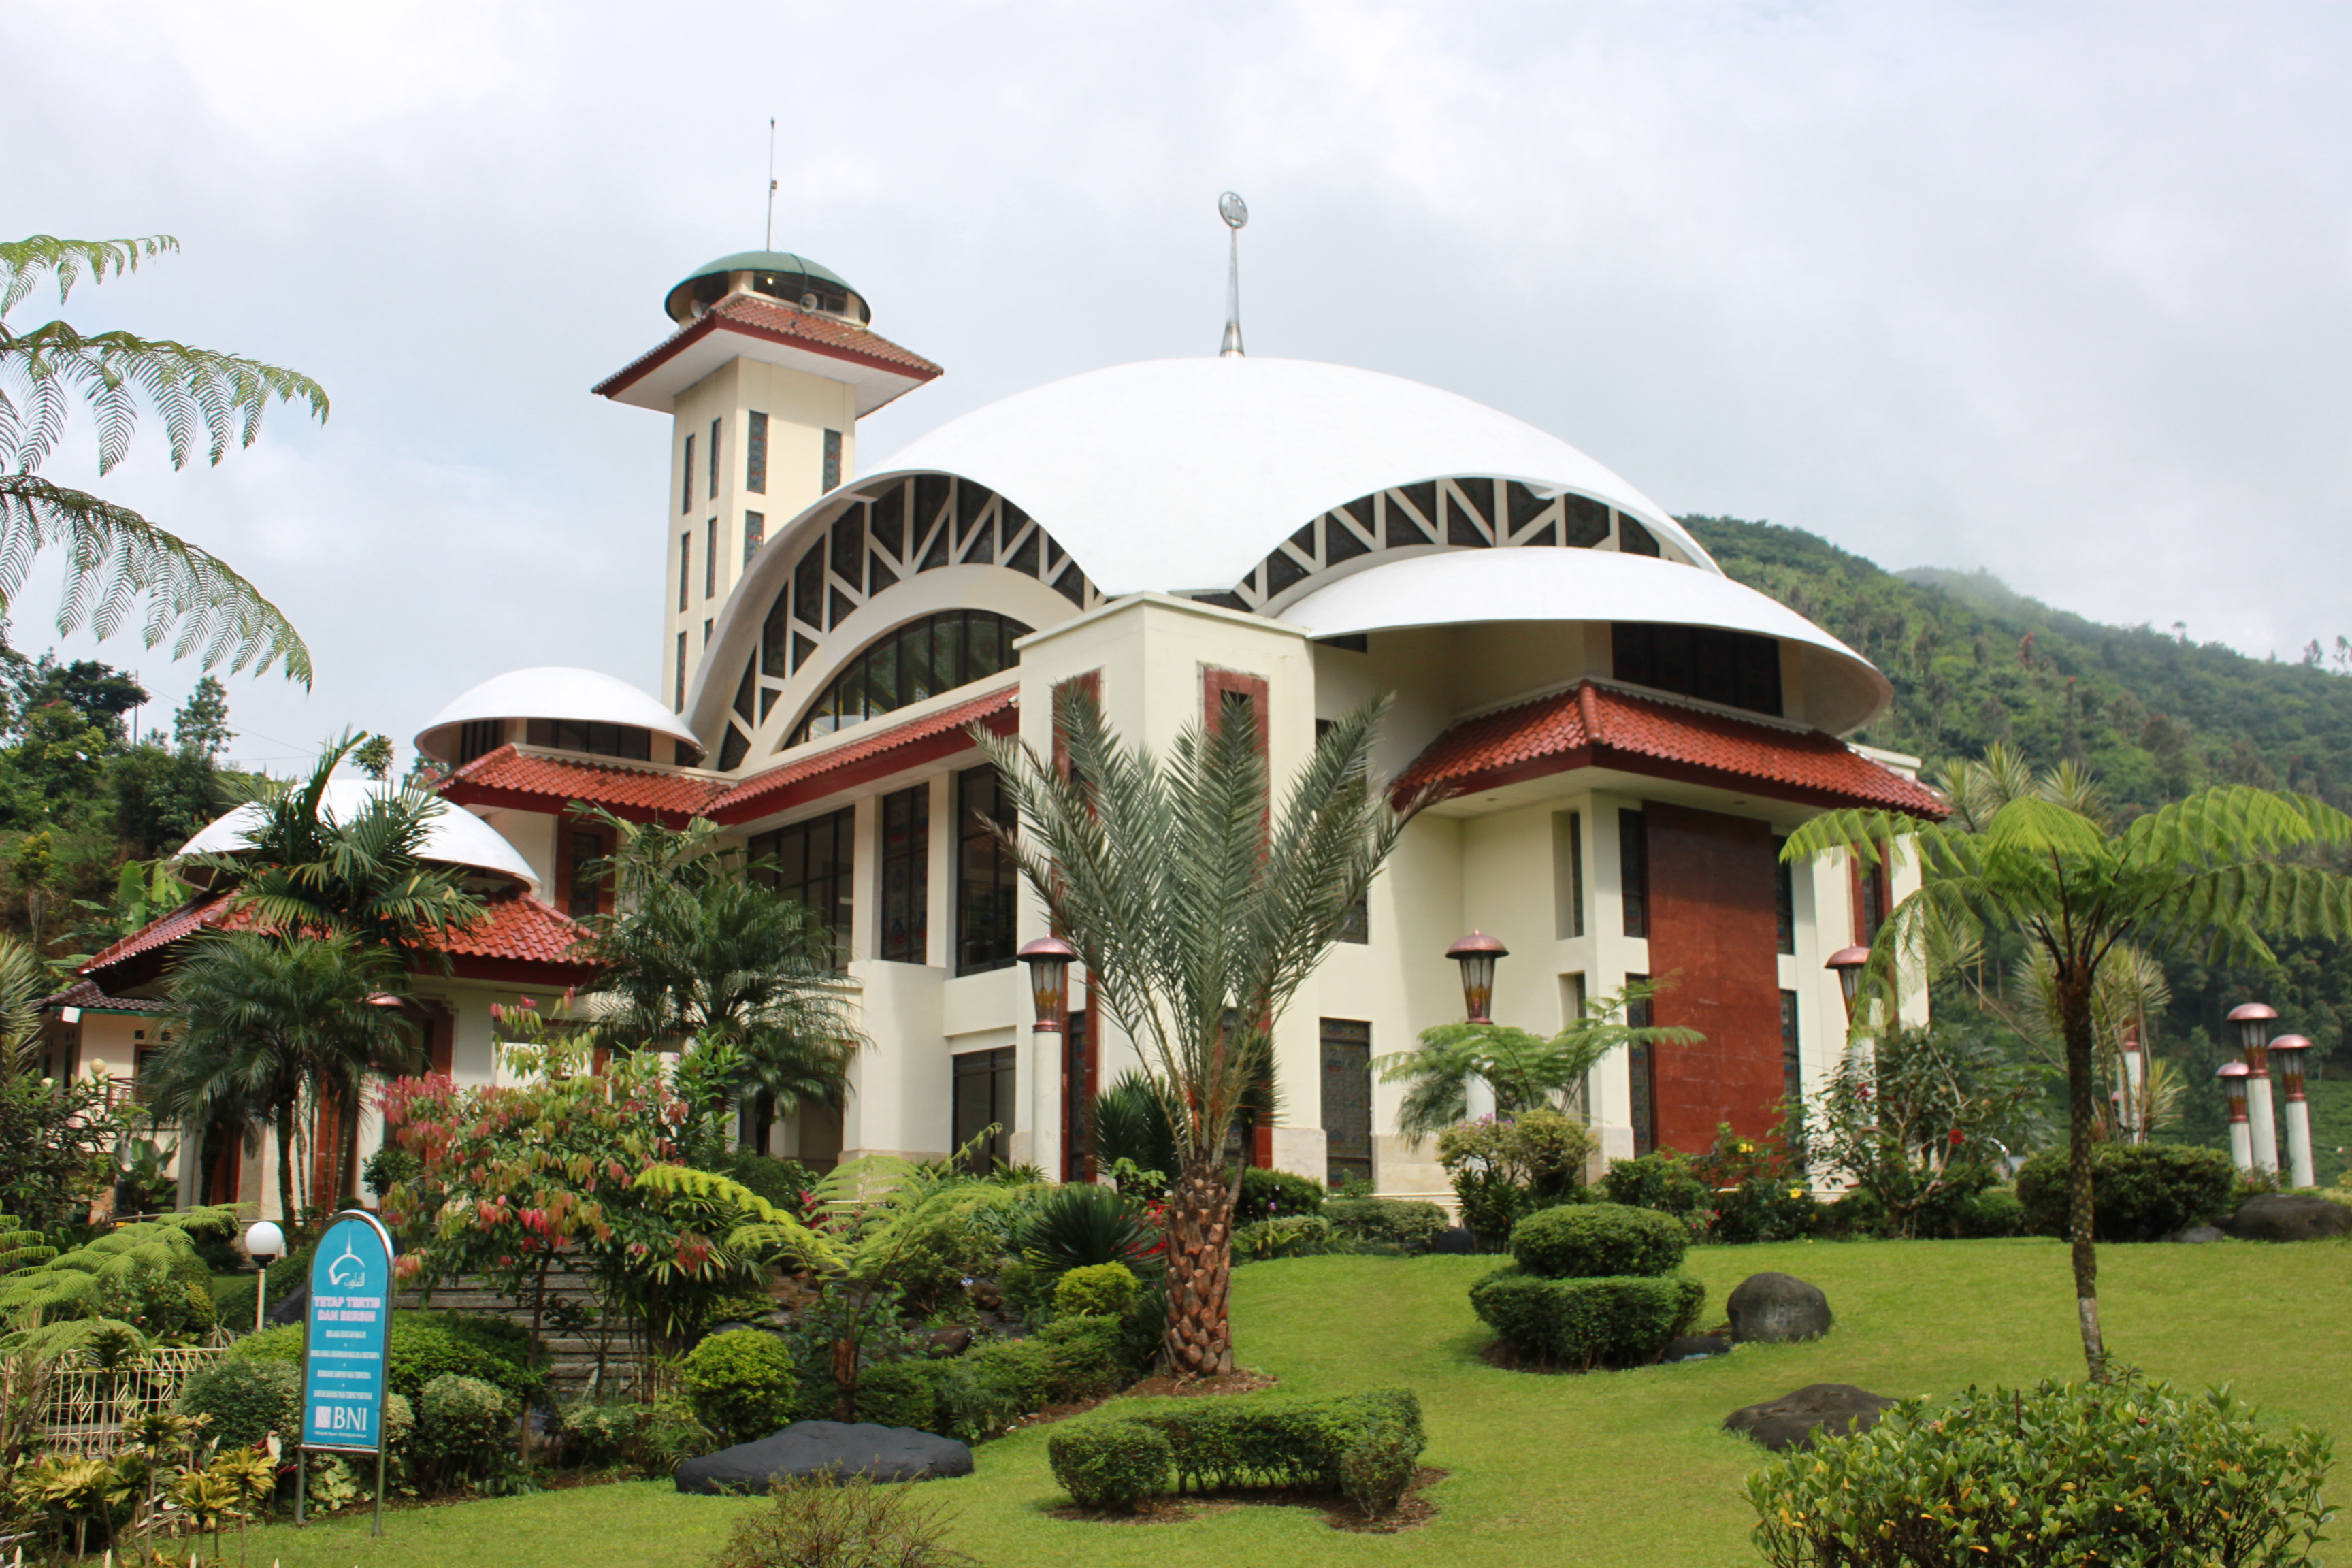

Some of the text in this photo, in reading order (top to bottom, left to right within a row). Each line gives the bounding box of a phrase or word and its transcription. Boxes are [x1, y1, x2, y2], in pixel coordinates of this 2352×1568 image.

[314, 1296, 381, 1309] TETAP TERTIB
[317, 1309, 376, 1322] DAN BERSIH
[333, 1406, 368, 1431] BNI
